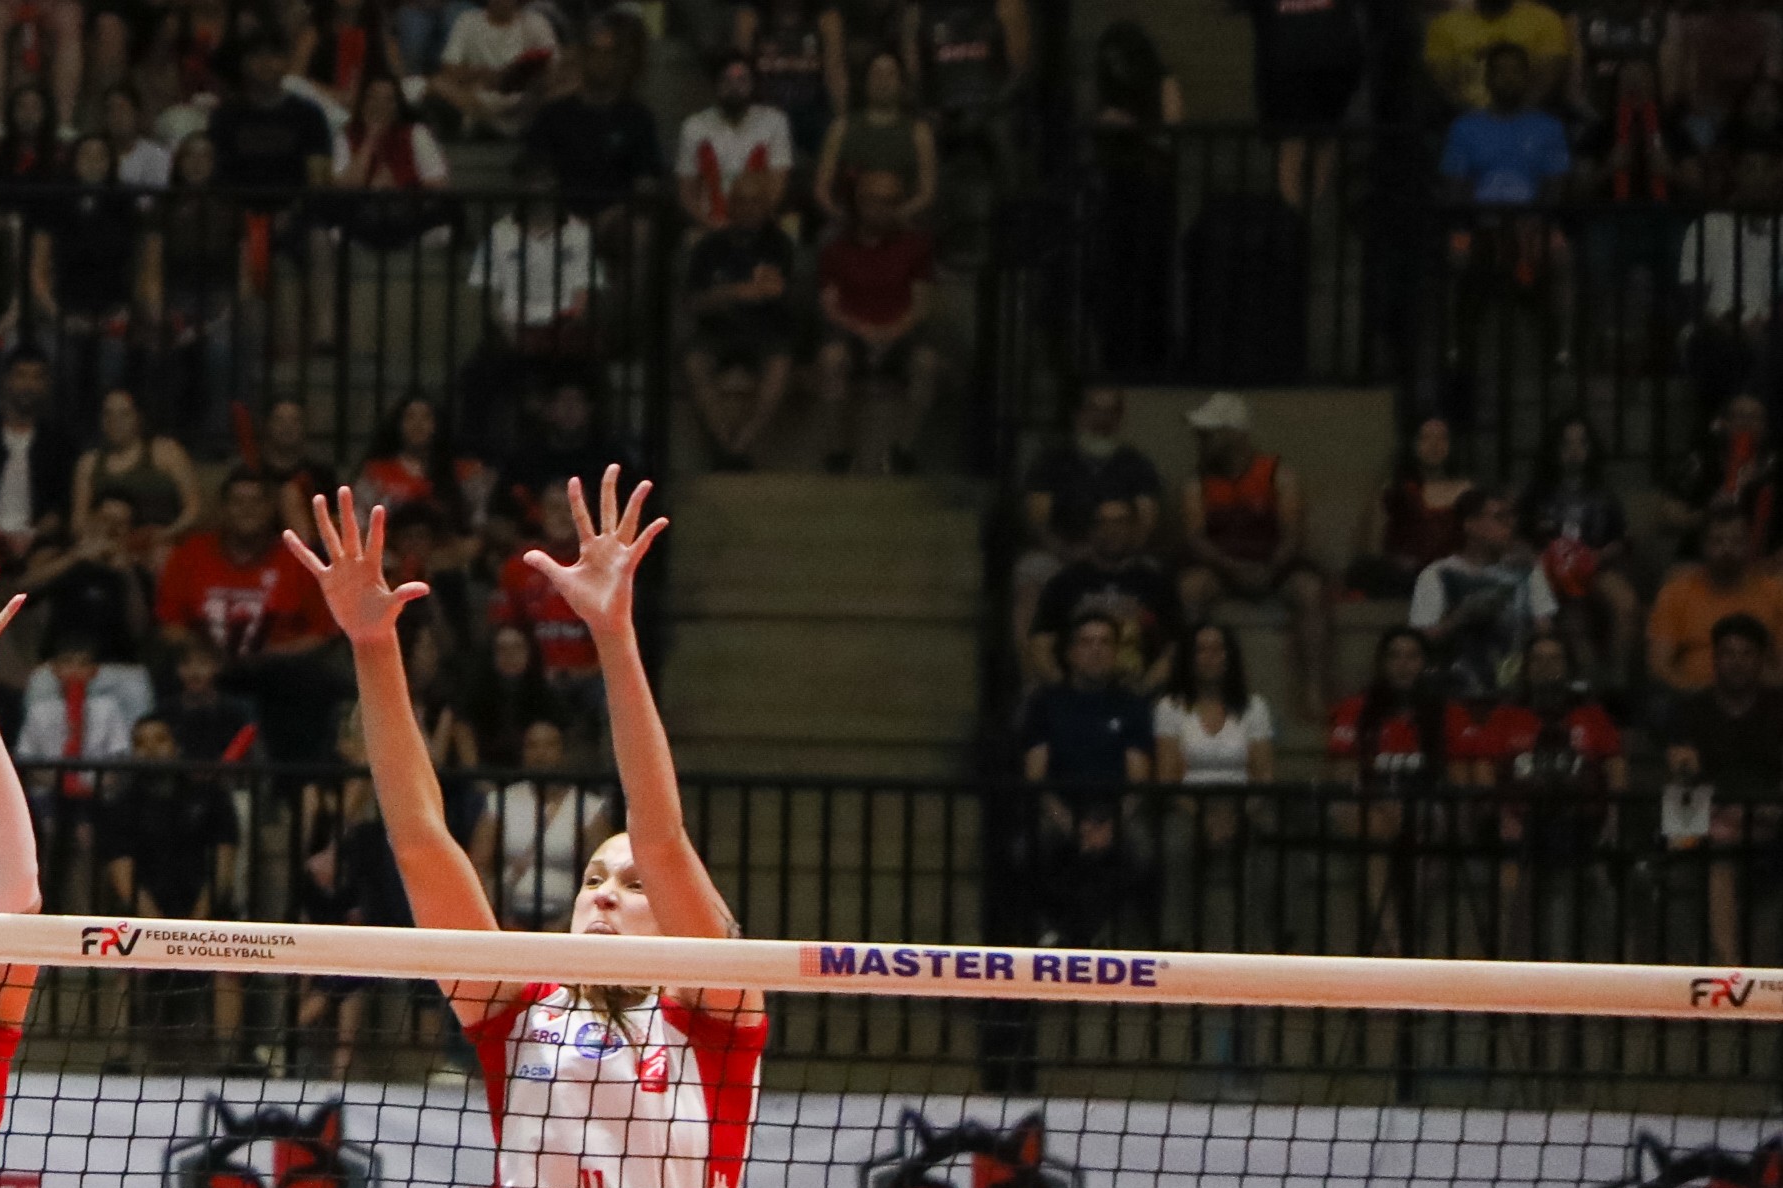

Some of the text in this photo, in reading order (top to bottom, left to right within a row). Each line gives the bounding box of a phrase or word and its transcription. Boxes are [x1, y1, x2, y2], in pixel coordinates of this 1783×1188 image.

[145, 930, 296, 946] FEDERAÇÃO PAULISTA
[166, 945, 275, 959] DE VOLLEYBALL
[819, 946, 1158, 987] MASTER REDE
